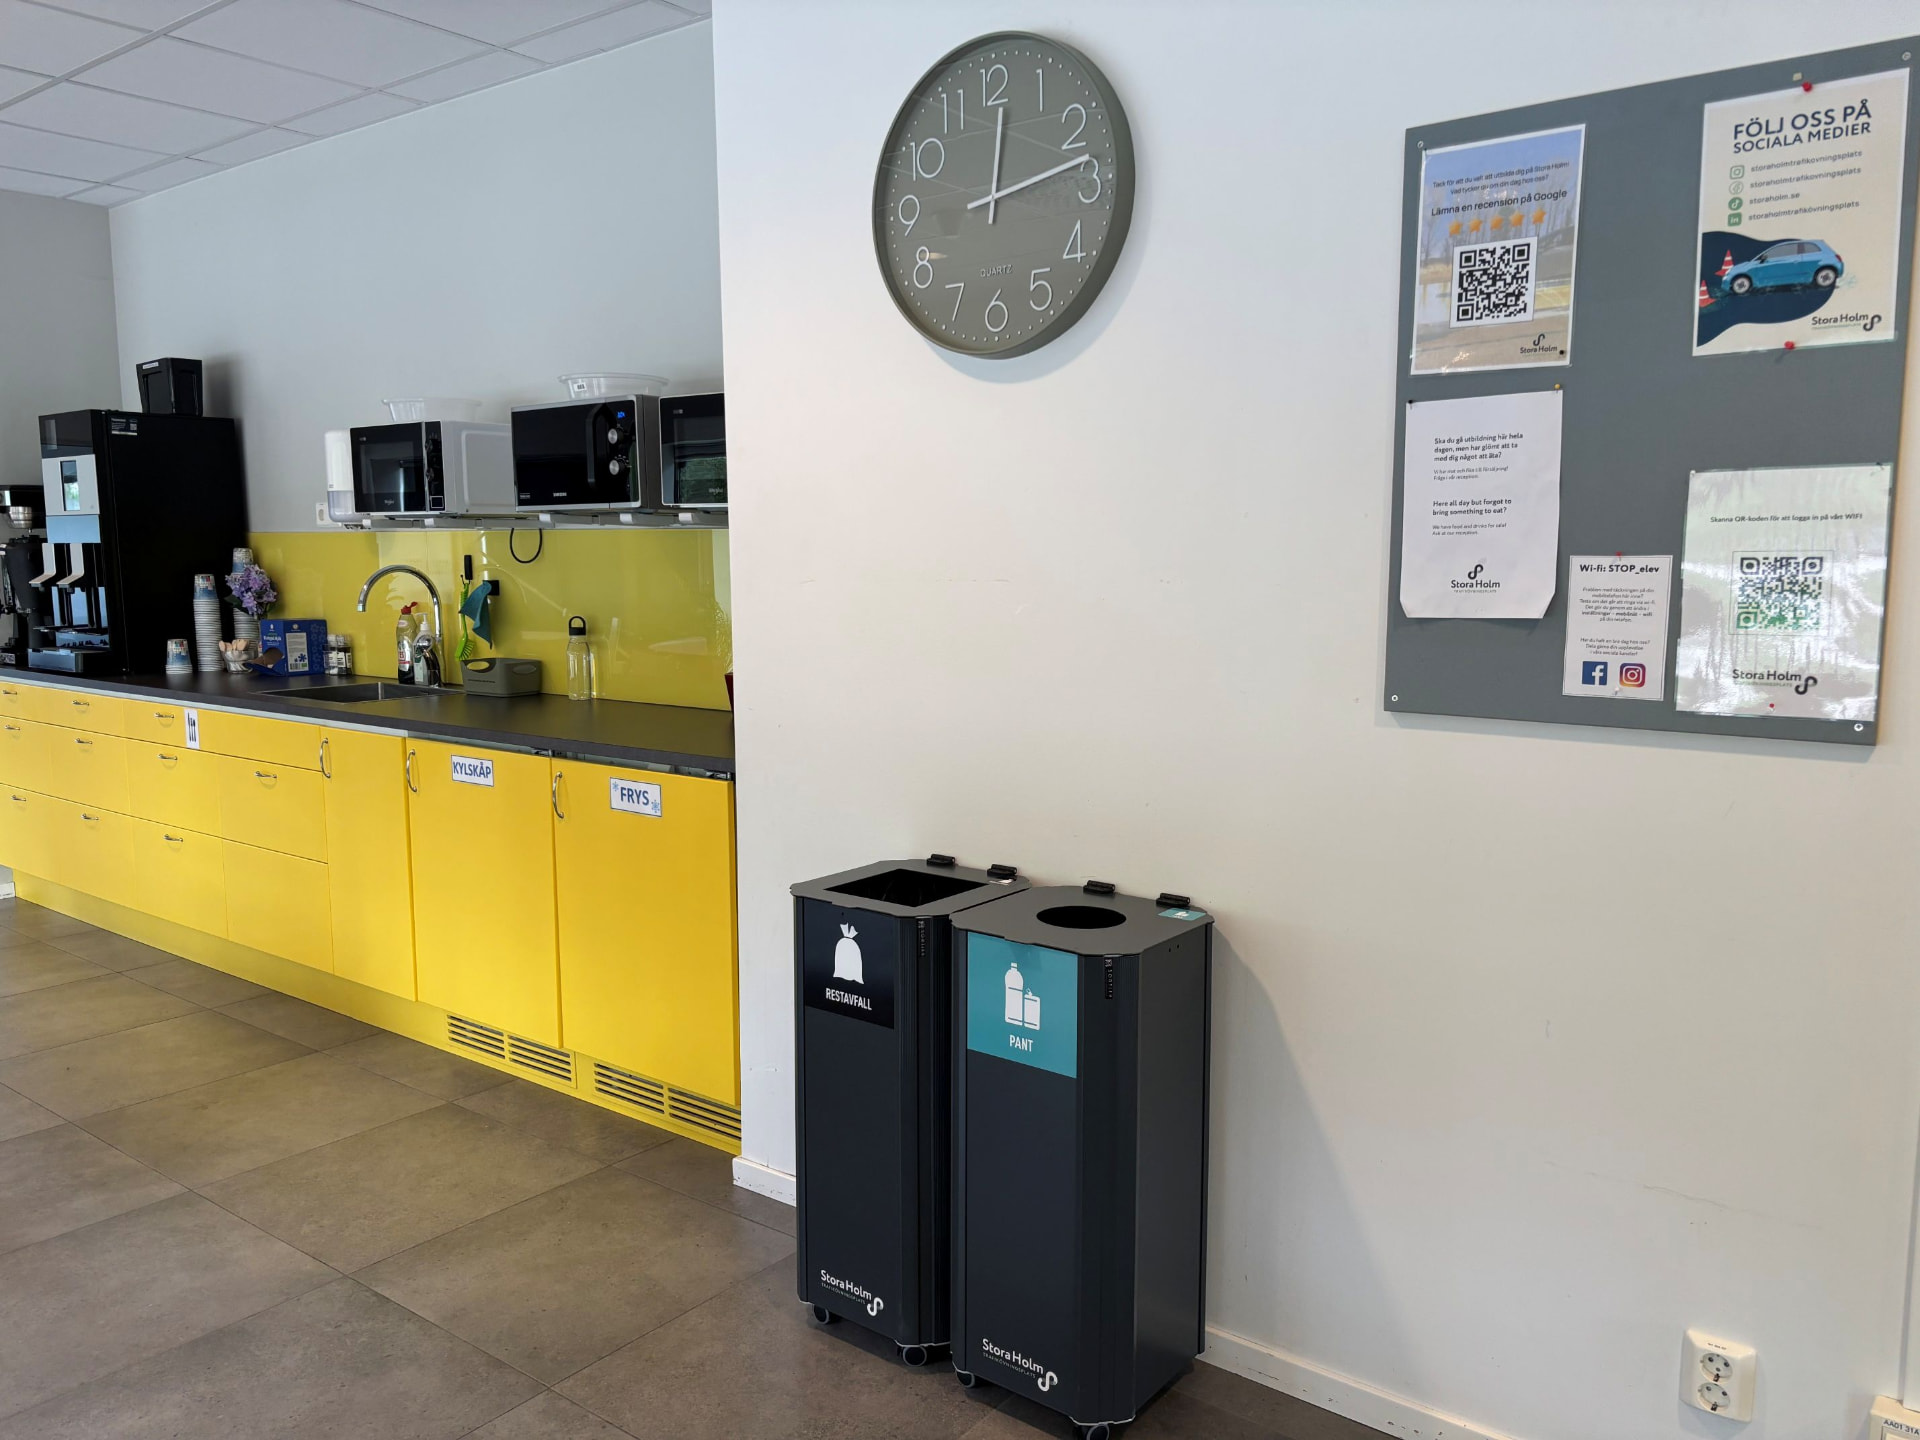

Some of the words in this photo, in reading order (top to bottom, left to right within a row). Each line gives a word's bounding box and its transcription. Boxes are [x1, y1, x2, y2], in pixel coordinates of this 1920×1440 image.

[979, 64, 1009, 107] 12
[1036, 68, 1044, 112] 1
[941, 88, 965, 134] 11
[1734, 117, 1785, 140] FÖLJ
[1791, 108, 1835, 129] OSS
[1843, 99, 1872, 122] PÅ
[1061, 103, 1087, 150] 2
[1733, 133, 1803, 154] SOCIALA
[1808, 122, 1871, 143] MEDIER
[910, 137, 945, 181] 10
[1516, 169, 1525, 177] dig
[1526, 166, 1533, 175] på
[1078, 157, 1101, 204] 3
[1462, 184, 1479, 194] tycker
[1510, 178, 1521, 187] dag
[1432, 204, 1459, 216] Lämna
[1462, 204, 1472, 212] en
[1474, 196, 1518, 210] recension
[1521, 193, 1532, 205] på
[1534, 190, 1567, 202] Google
[1750, 193, 1800, 204] storaholm.se
[898, 194, 921, 237] 9
[1063, 219, 1087, 263] 4
[912, 246, 933, 289] 8
[980, 264, 1013, 278] QUARTZ
[944, 282, 965, 322] 7
[1029, 267, 1053, 311] 5
[984, 288, 1009, 333] 6
[1812, 316, 1838, 326] Stora
[1840, 313, 1868, 324] Holm
[1520, 346, 1537, 354] Stora
[1460, 454, 1477, 462] något
[1580, 564, 1606, 573] Wi-fi:
[1608, 565, 1659, 574] STOP_elev
[1451, 580, 1473, 588] Stora
[1476, 580, 1500, 588] Holm
[1733, 669, 1764, 679] Stora
[1767, 670, 1801, 681] Holm
[453, 761, 491, 779] KYLSKÅP
[620, 787, 649, 806] FRYS
[825, 987, 872, 1011] RESTAVFALL
[1009, 1034, 1034, 1052] PANT
[821, 1270, 844, 1289] Stora
[846, 1280, 871, 1300] Holm
[983, 1338, 1010, 1360] Stora
[1013, 1351, 1043, 1374] Holm
[1884, 1419, 1902, 1430] AA01
[1905, 1426, 1919, 1435] 31A
